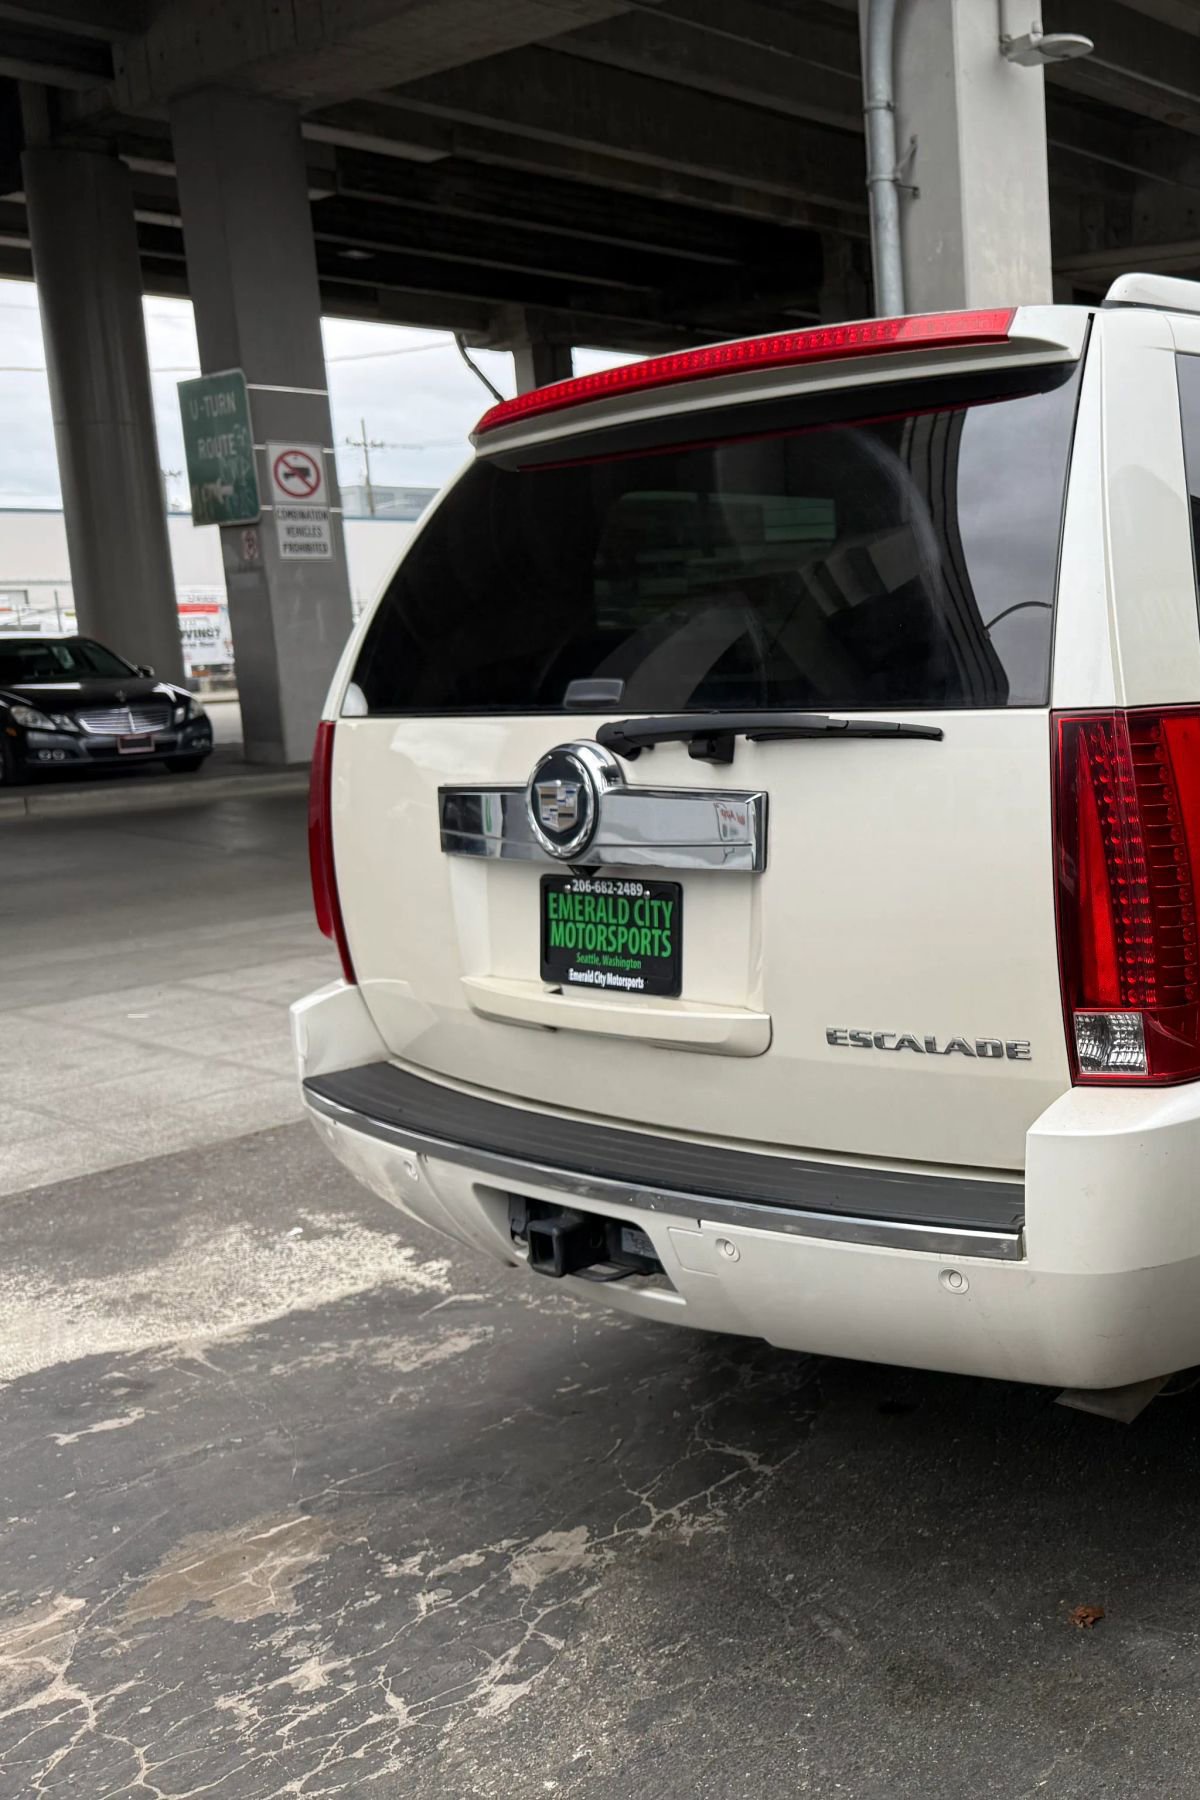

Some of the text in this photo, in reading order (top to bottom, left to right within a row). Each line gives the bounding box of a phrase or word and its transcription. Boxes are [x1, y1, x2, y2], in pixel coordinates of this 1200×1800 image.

[189, 392, 237, 421] U-TURN
[197, 432, 237, 459] ROUTE
[572, 879, 644, 896] 206-682-2489
[547, 892, 673, 928] EMERALD CITY
[549, 921, 673, 958] MOTORSPORTS
[602, 955, 642, 971] Washington
[568, 968, 645, 990] Emerald City Motorsports
[825, 1026, 1033, 1061] ESCALADE
